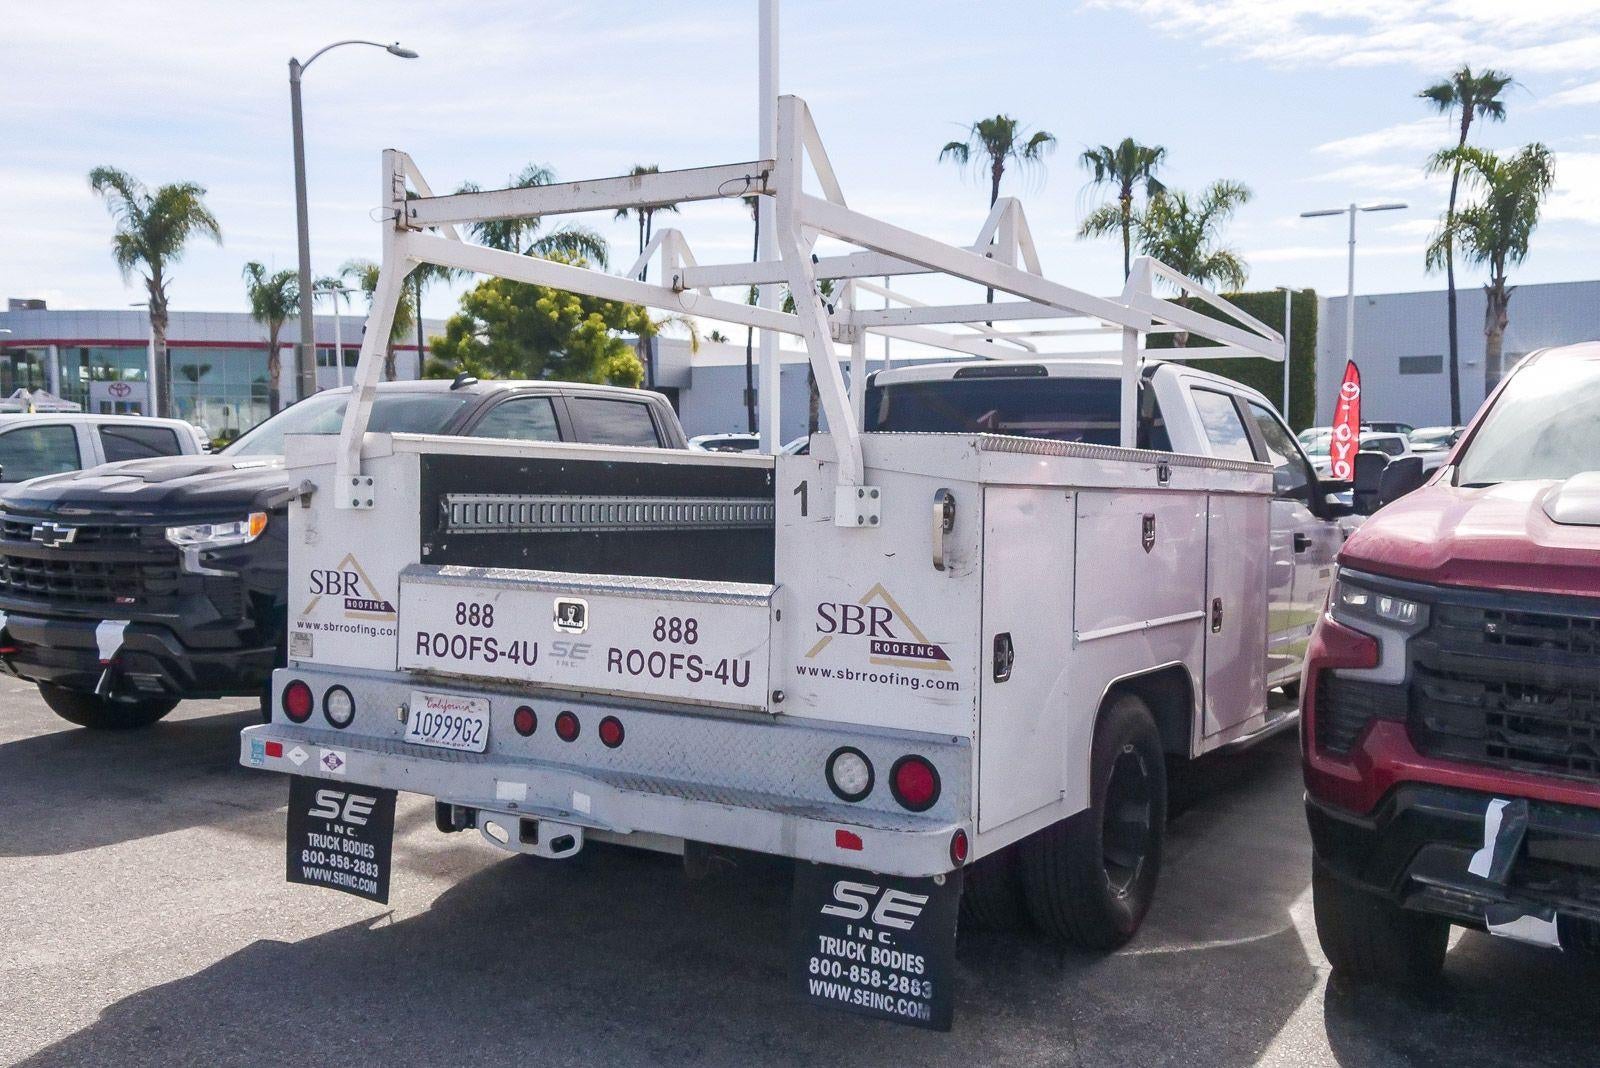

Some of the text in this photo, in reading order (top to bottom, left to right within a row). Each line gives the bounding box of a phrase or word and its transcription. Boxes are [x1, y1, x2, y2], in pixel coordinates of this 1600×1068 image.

[794, 480, 808, 516] 1
[310, 569, 361, 597] SBR
[346, 600, 385, 610] ROOFING
[455, 601, 494, 629] 888
[652, 616, 698, 645] 888
[815, 602, 897, 638] SBR
[416, 631, 538, 667] ROOFS-4U
[549, 641, 592, 660] SE
[874, 642, 934, 657] ROOFING
[607, 647, 750, 688] ROOFS-4U
[796, 665, 960, 691] www.sbrroofing.com
[425, 698, 473, 714] California
[411, 711, 483, 744] 10999G2
[308, 789, 376, 825] SE
[307, 832, 375, 859] TRUCK BODIES
[302, 849, 379, 878] 800-858-2883
[303, 866, 377, 894] WWW.SEINC.COM
[821, 881, 929, 930] SE
[846, 924, 897, 945] INC.
[819, 935, 925, 975] TRUCK BODIES
[808, 957, 933, 1000] 800-858-2883
[809, 979, 931, 1021] WWW.SEINC.COM
